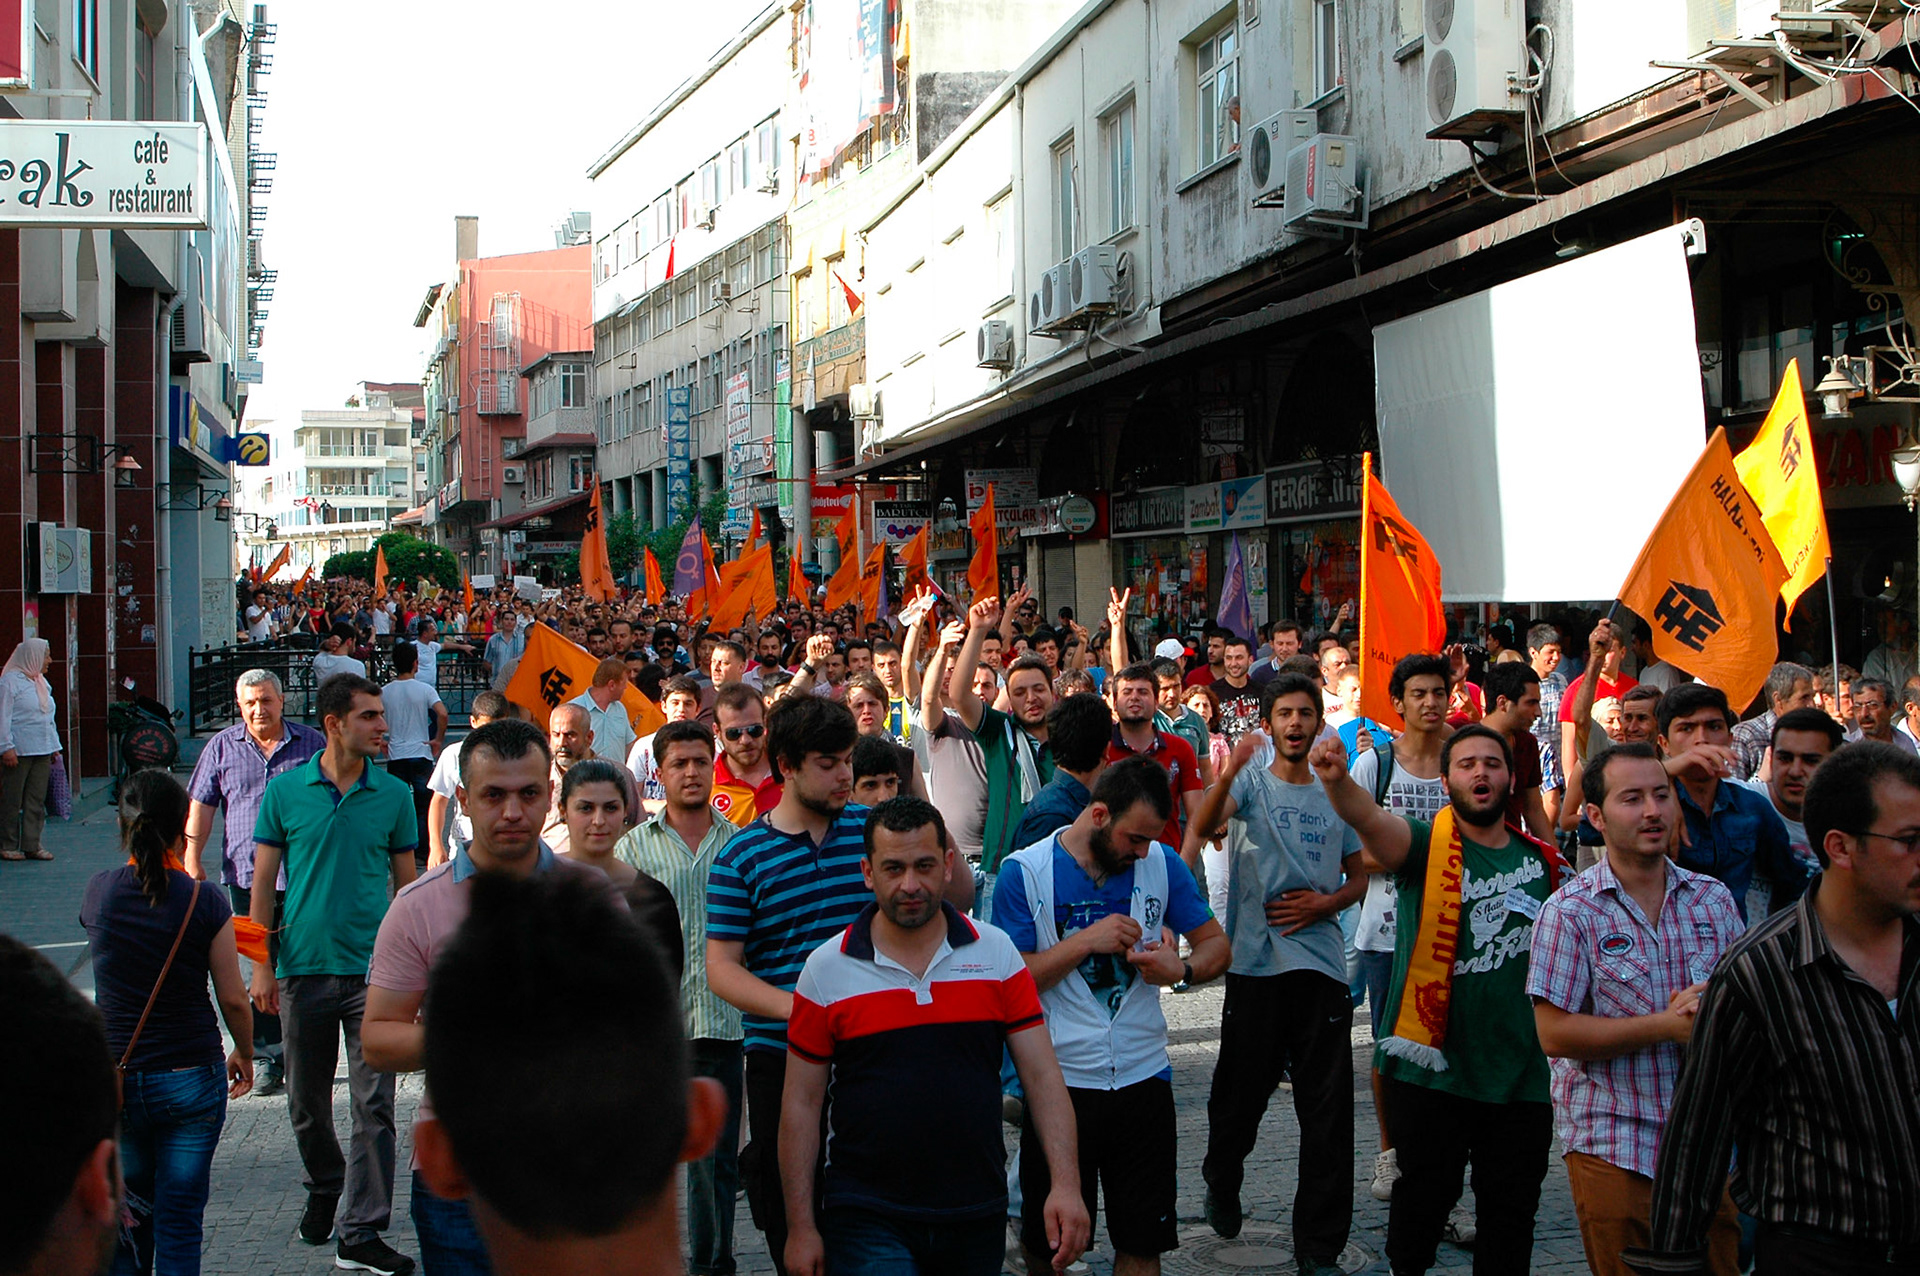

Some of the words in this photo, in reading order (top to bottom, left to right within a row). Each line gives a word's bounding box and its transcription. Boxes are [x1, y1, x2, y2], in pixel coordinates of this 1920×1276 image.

[134, 132, 169, 164] cafe
[145, 168, 157, 185] &
[109, 182, 193, 213] restaurant
[1114, 501, 1138, 529] FERAH
[1300, 812, 1328, 827] don't
[1300, 831, 1327, 845] poke
[1306, 850, 1322, 862] me
